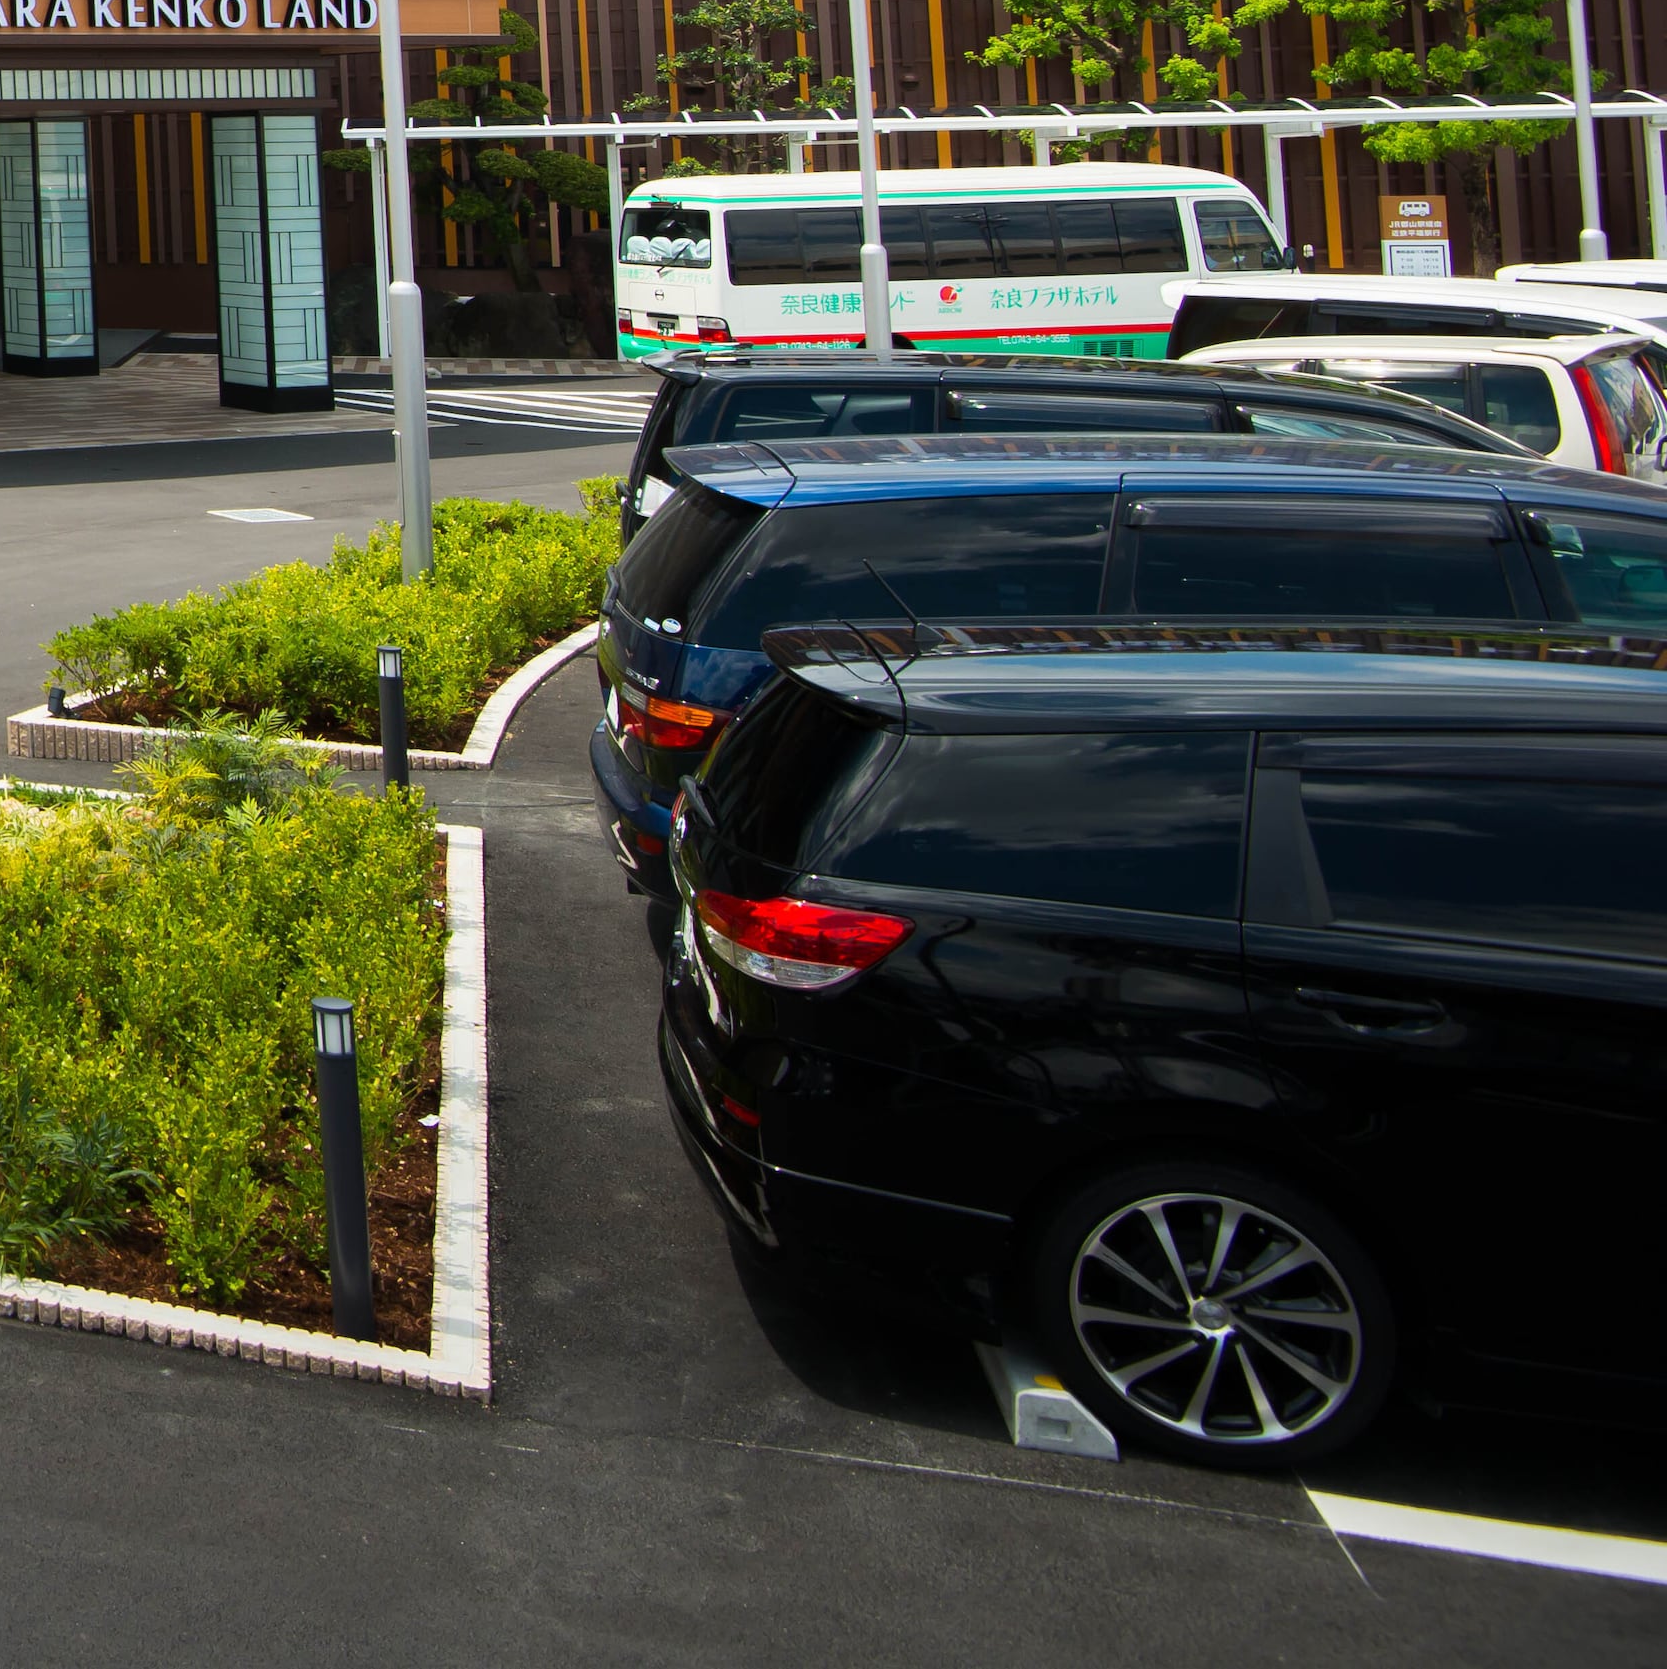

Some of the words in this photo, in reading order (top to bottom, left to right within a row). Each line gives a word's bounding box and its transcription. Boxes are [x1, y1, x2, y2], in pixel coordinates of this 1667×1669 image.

[780, 291, 916, 316] 奈良健康ンド
